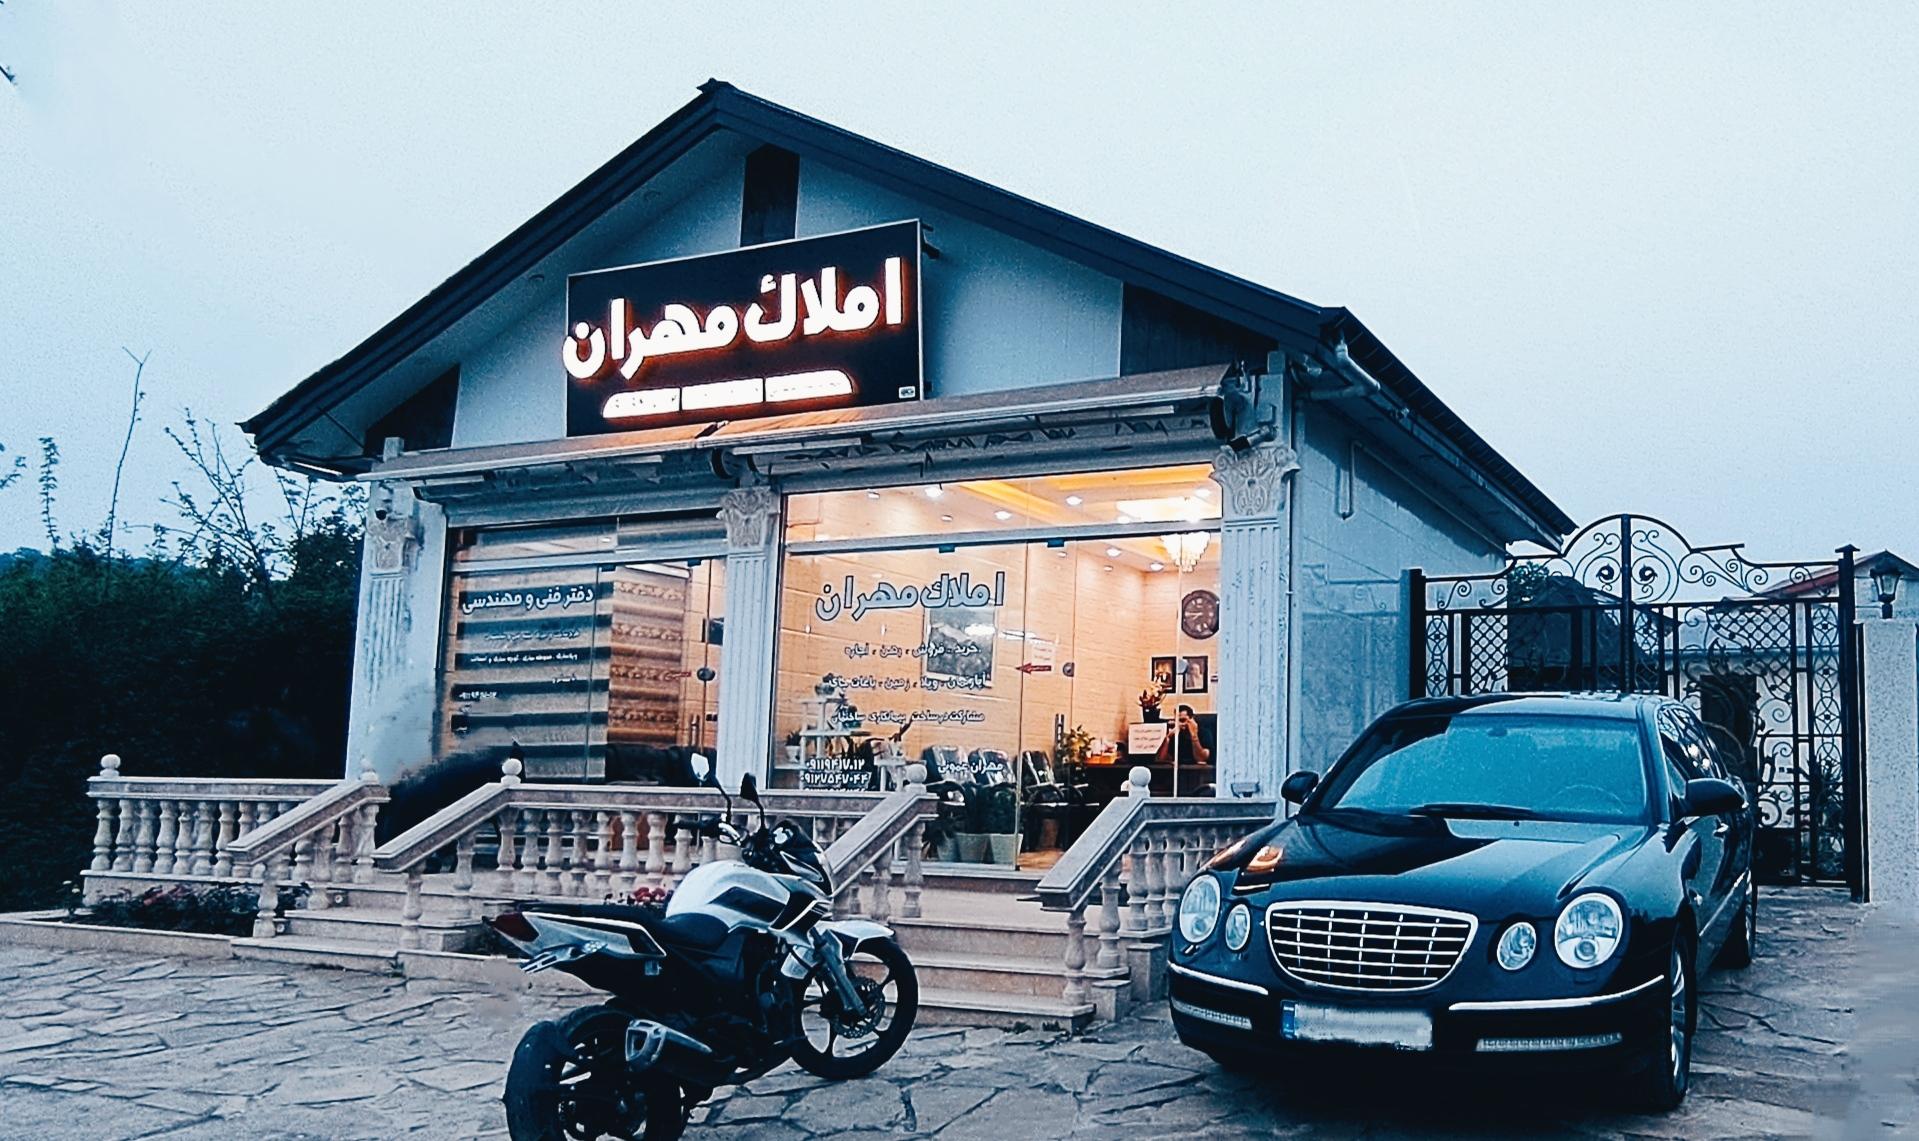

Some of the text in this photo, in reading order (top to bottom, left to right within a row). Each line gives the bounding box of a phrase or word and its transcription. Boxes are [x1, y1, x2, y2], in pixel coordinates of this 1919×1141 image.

[562, 297, 739, 380] مهران
[462, 585, 594, 615] دفتر فنی و مهندسی
[815, 575, 919, 622] مهران
[970, 759, 1004, 775] مهران
